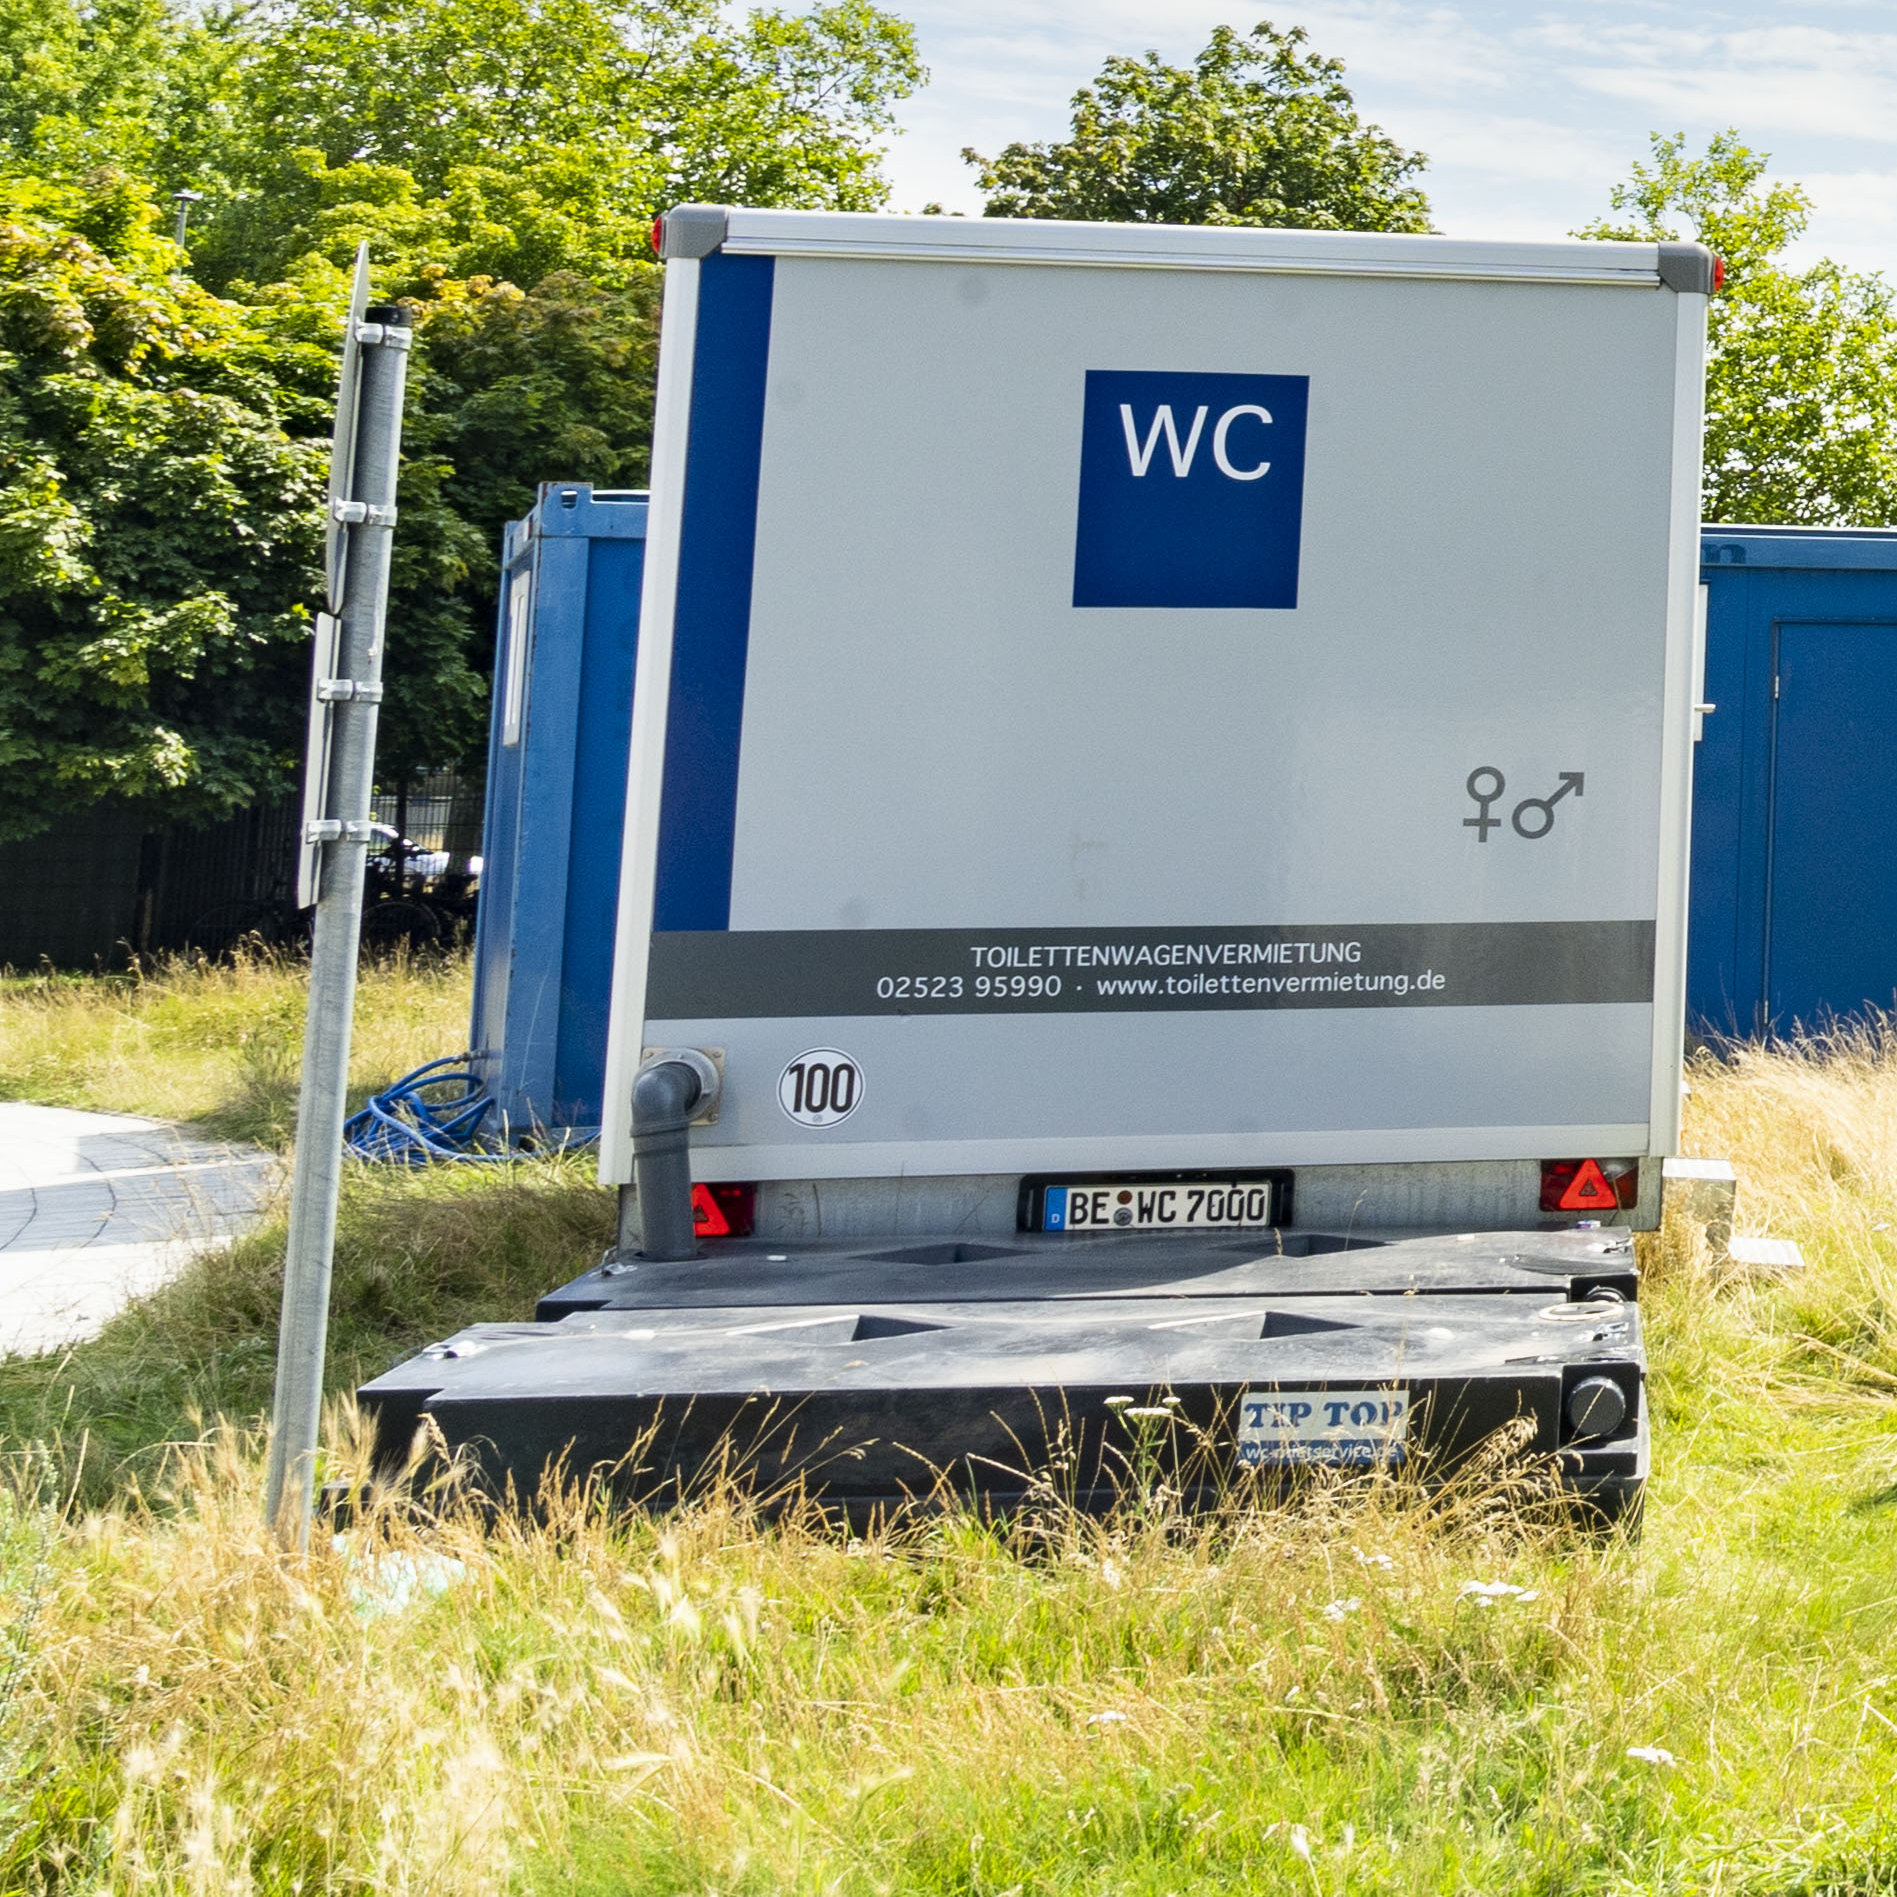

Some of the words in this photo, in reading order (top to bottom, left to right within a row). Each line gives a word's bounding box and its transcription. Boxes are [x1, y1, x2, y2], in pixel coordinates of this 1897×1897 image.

[1119, 403, 1274, 481] WC
[970, 941, 1362, 968] TOILETTENWAGENVERMIETUNG
[876, 975, 964, 999] 02523
[974, 975, 1062, 998] 95990
[1096, 969, 1446, 996] www.toilettenvermietung.de
[788, 1062, 856, 1114] 100
[1051, 1213, 1061, 1224] D
[1069, 1191, 1111, 1225] BE
[1138, 1190, 1177, 1224] WC
[1186, 1188, 1266, 1223] 7000
[1244, 1402, 1313, 1428] TIP
[1323, 1400, 1404, 1427] TOP
